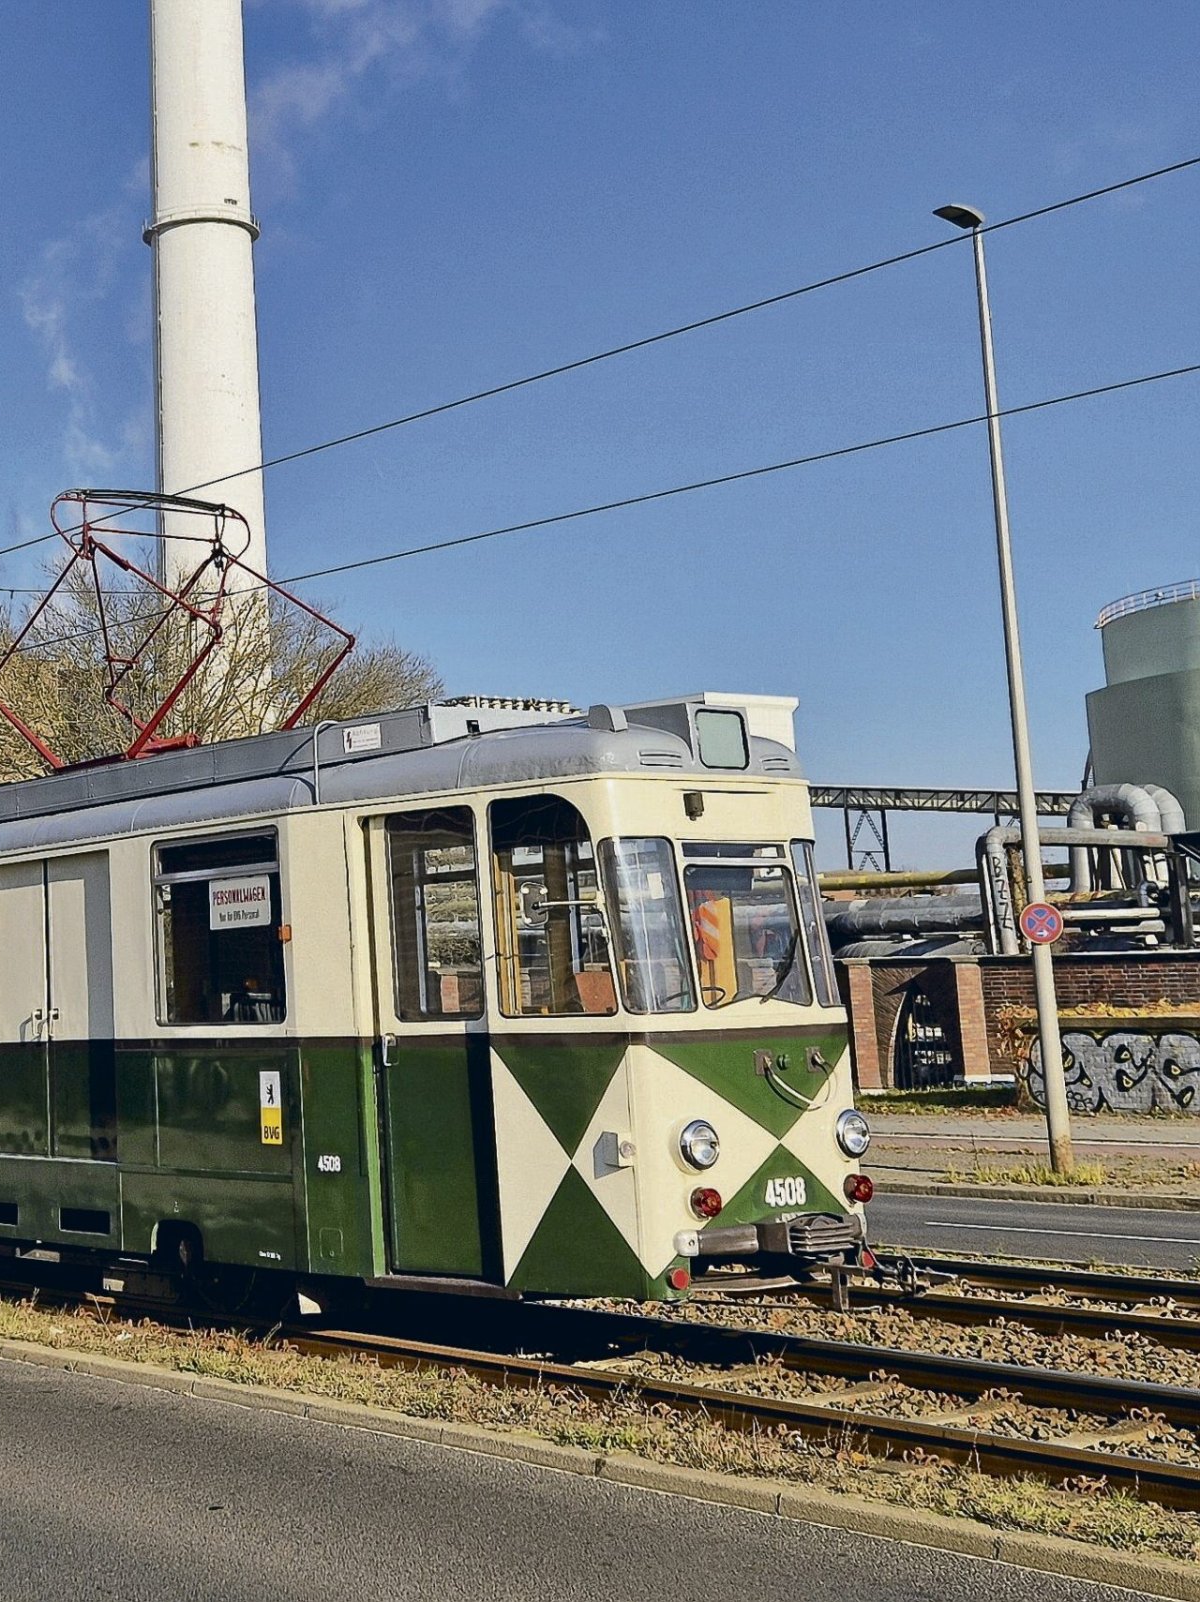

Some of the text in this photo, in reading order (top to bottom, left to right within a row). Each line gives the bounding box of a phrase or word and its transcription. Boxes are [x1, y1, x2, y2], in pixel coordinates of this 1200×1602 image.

[263, 1125, 280, 1140] BVG
[317, 1155, 342, 1172] 4508
[765, 1176, 807, 1208] 4508
